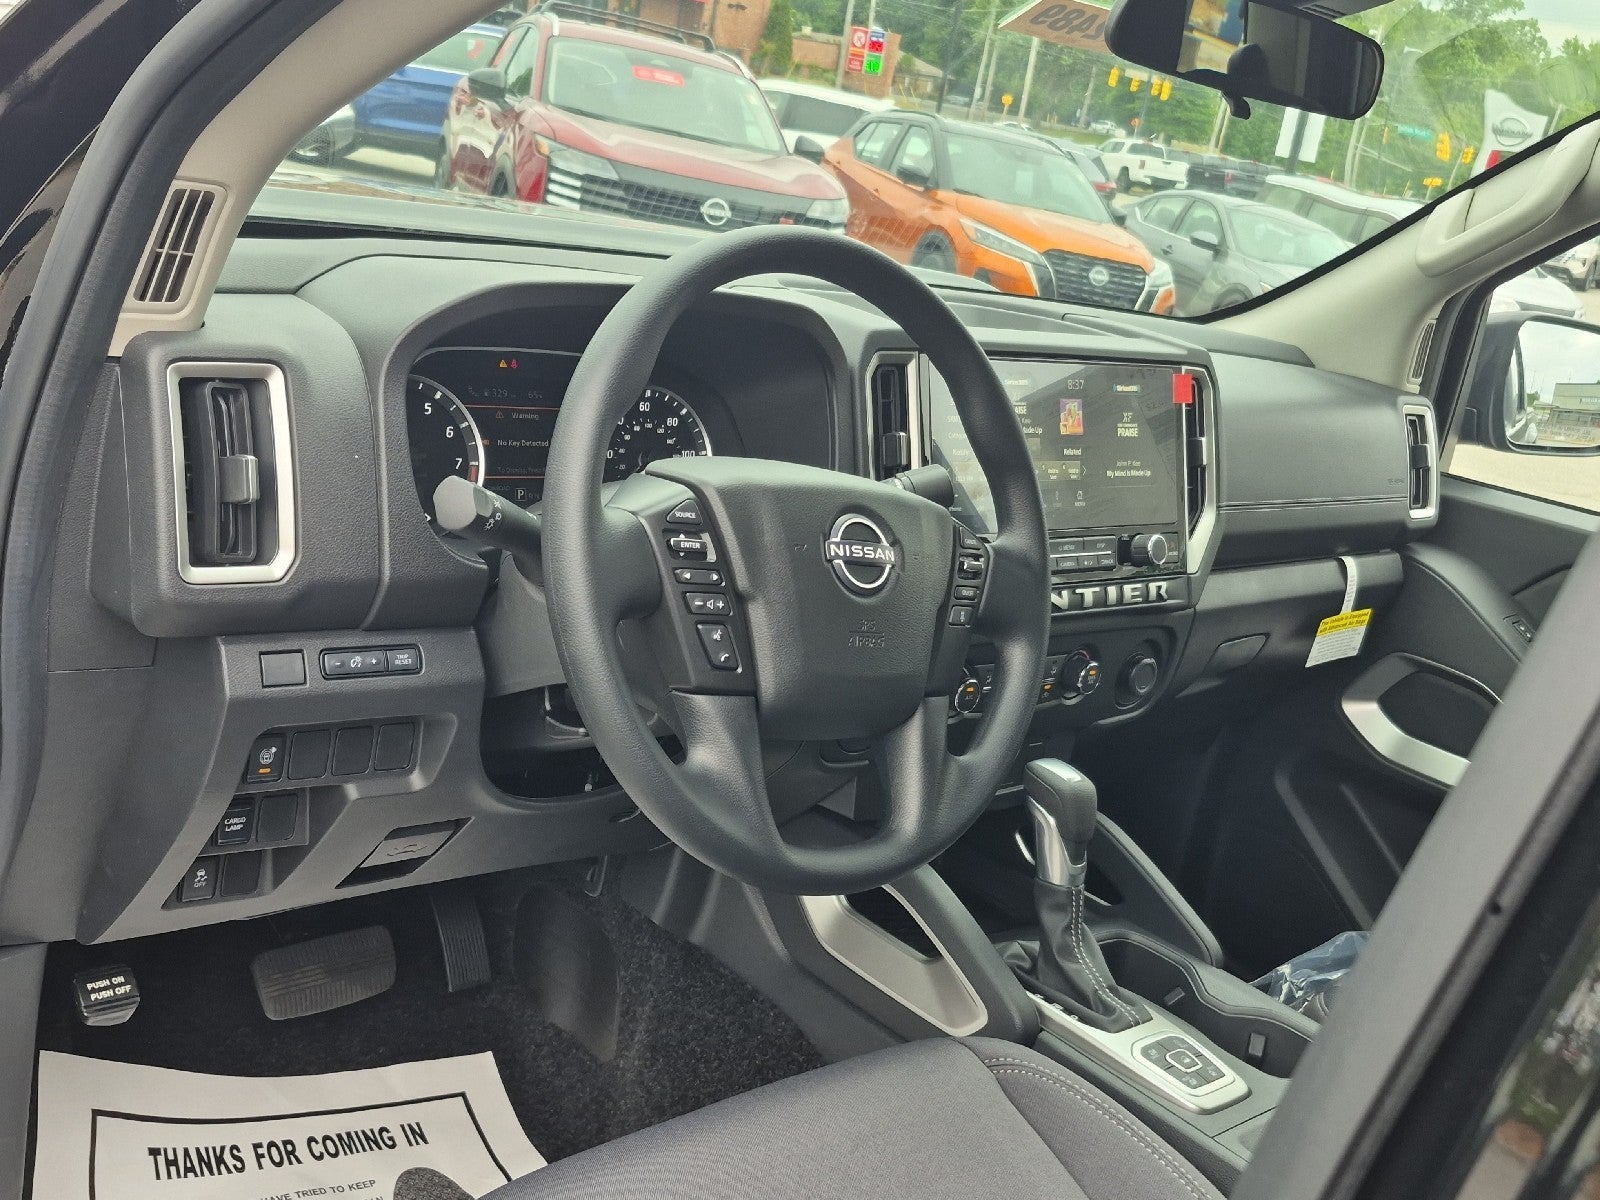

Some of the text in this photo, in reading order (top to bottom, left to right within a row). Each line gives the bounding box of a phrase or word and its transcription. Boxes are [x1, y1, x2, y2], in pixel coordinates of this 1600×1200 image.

[1067, 379, 1084, 390] 8:37
[424, 403, 432, 414] 5
[639, 402, 650, 411] 60
[511, 412, 540, 420] Warning
[666, 417, 678, 427] 80
[446, 426, 454, 438] 6
[1117, 428, 1139, 437] PRAISE
[508, 439, 520, 448] Key
[521, 439, 549, 448] Detected
[1063, 448, 1082, 456] Related
[455, 457, 463, 470] 7
[516, 489, 524, 498] P
[674, 510, 697, 519] SOURCE
[680, 541, 701, 550] ENTER
[829, 544, 896, 562] NISSAN
[848, 634, 885, 648] AIRBAG
[394, 658, 412, 666] RESET
[224, 816, 247, 825] CARGO
[225, 824, 244, 832] LAMP
[86, 975, 125, 991] PUSH ON
[90, 984, 132, 1002] PUSH OFF
[148, 1121, 430, 1182] THANKS FOR COMING IN
[294, 1186, 327, 1199] TRIED
[329, 1185, 345, 1194] TO
[348, 1179, 376, 1192] KEEP
